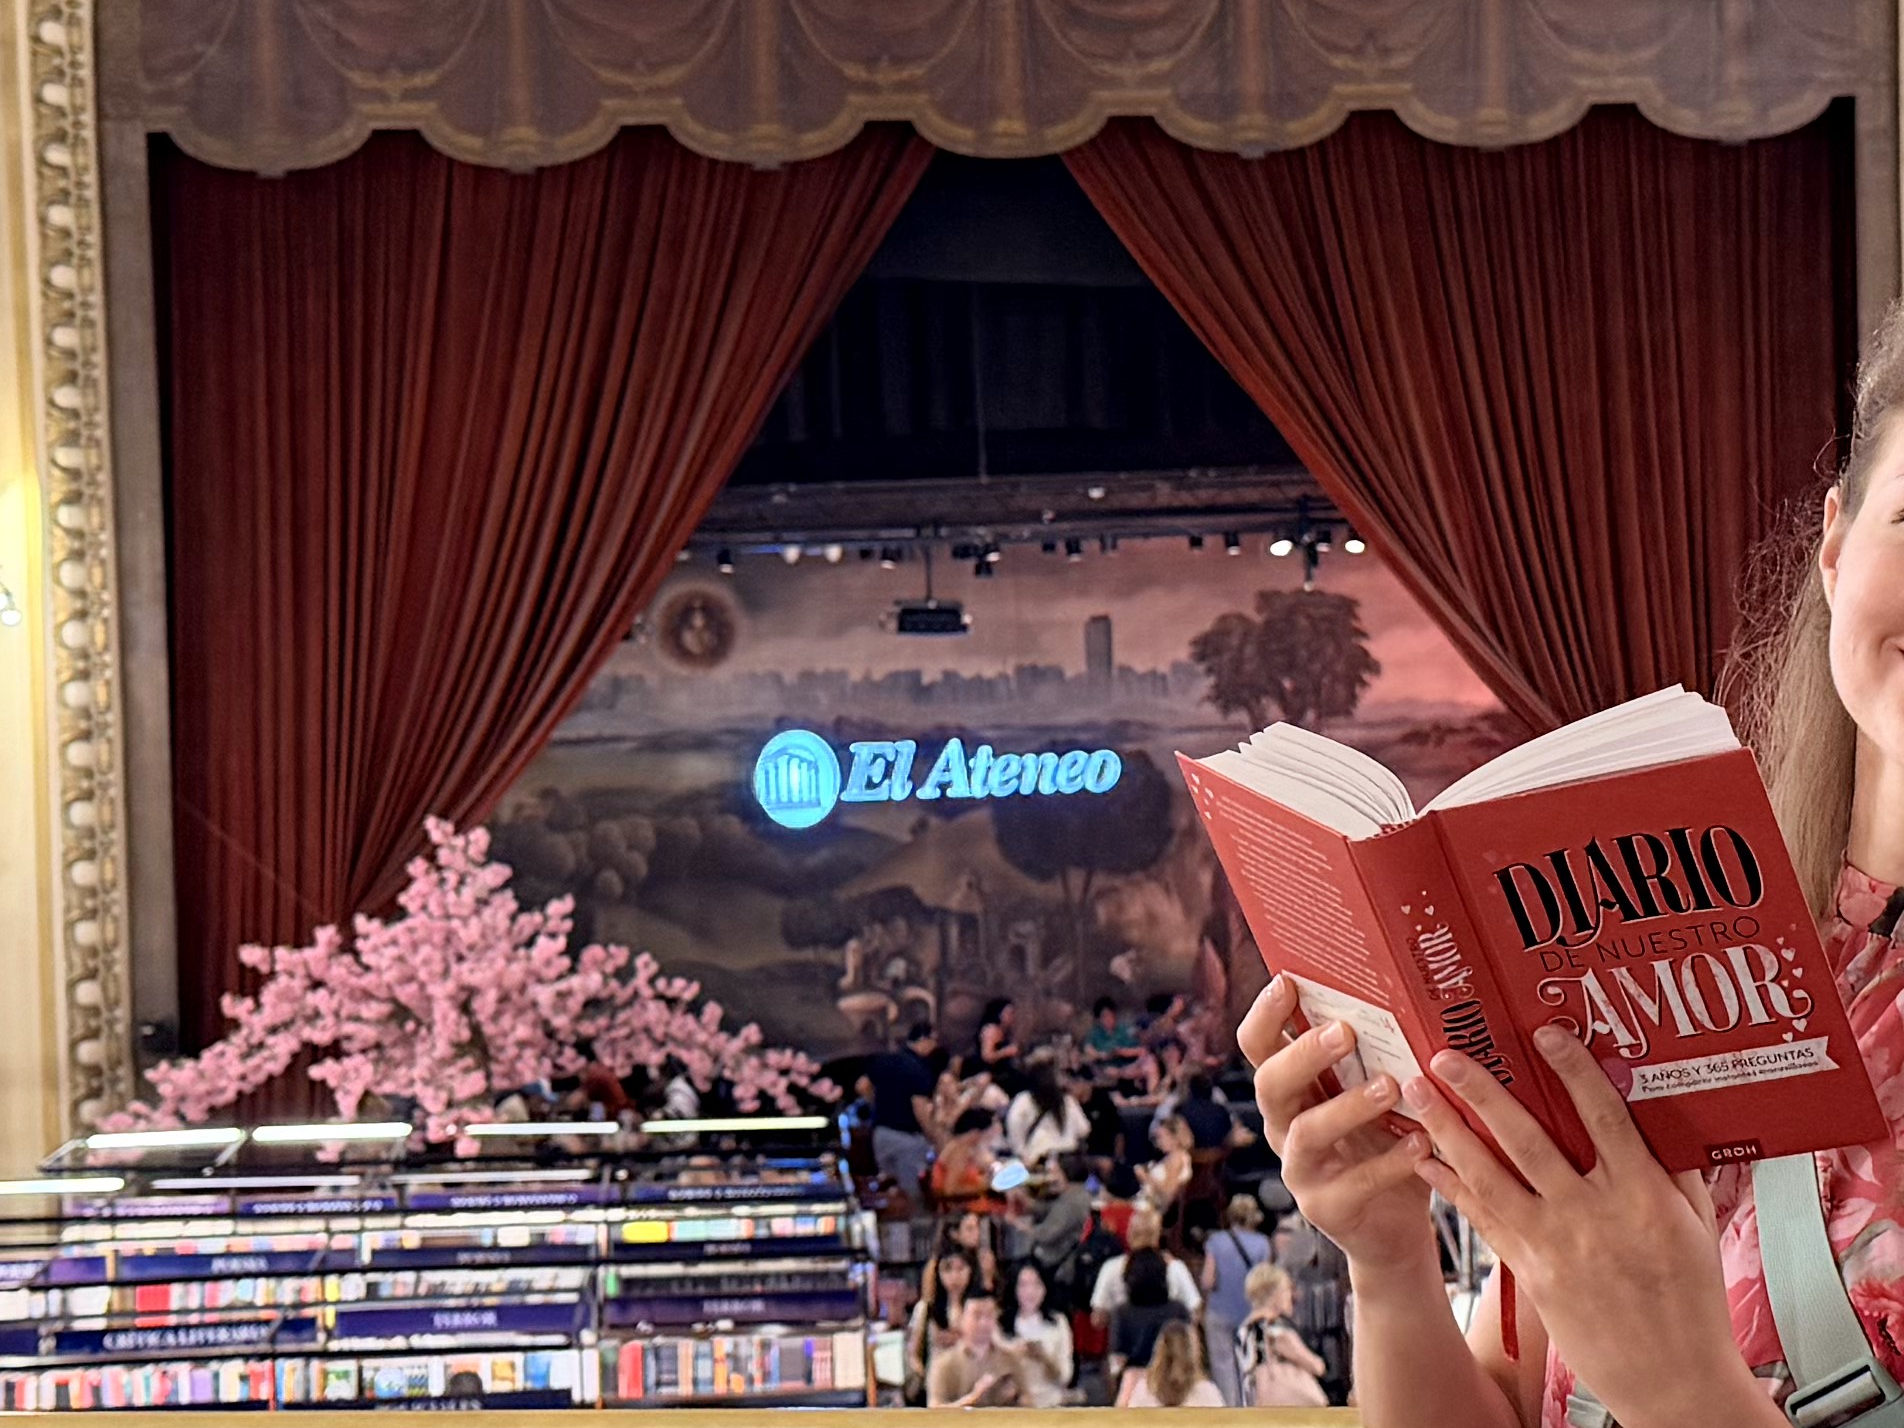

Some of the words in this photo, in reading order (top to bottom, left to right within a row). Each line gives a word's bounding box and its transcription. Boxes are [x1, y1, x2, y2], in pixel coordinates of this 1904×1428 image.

[840, 739, 917, 803] El
[915, 737, 1122, 800] Ateneo
[1493, 824, 1765, 953] DIARIO
[1539, 949, 1585, 972] DE
[1595, 915, 1761, 964] NUESTRO
[1537, 943, 1815, 1059] AMOR
[1731, 1046, 1815, 1070] PREGUNTAS
